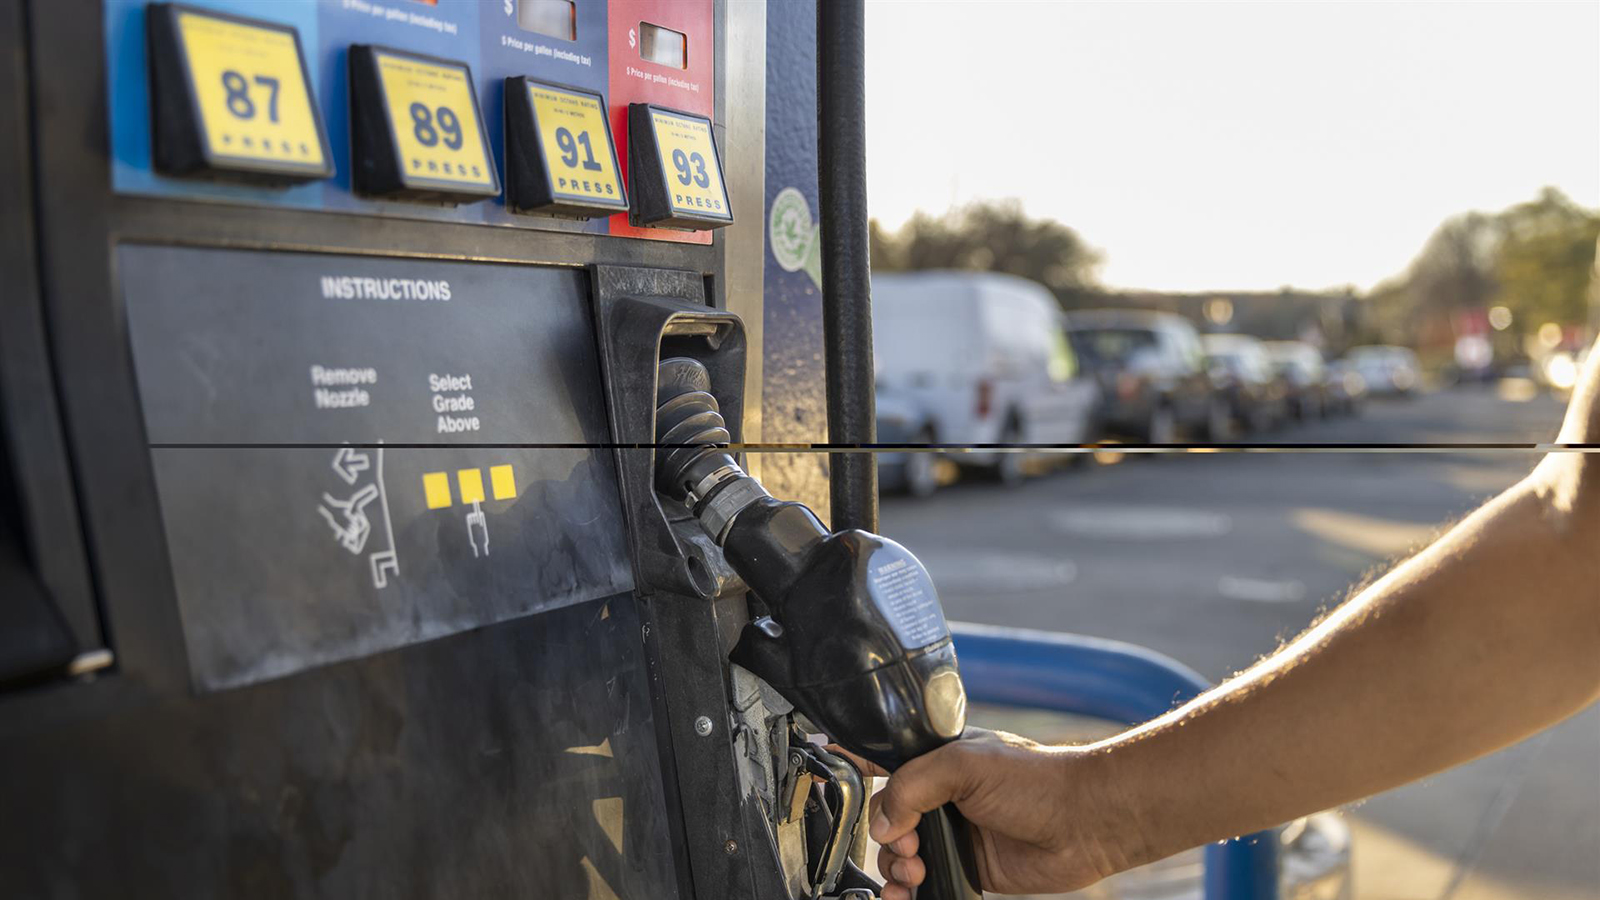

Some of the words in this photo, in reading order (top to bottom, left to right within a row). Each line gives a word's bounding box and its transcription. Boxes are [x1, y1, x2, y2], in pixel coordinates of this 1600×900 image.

[386, 8, 409, 22] gallon
[628, 28, 636, 50] $
[501, 35, 507, 46] $
[507, 36, 523, 50] Price
[524, 42, 534, 53] per
[535, 45, 553, 56] gallon
[553, 48, 580, 65] (including
[580, 55, 592, 67] tax)
[626, 66, 630, 76] $
[631, 67, 644, 79] Price
[644, 72, 652, 81] per
[653, 74, 668, 84] gallon
[668, 77, 690, 91] (including
[690, 82, 700, 93] tax)
[221, 70, 281, 124] 87
[409, 102, 464, 151] 89
[555, 126, 603, 173] 91
[412, 159, 482, 179] PRESS
[672, 148, 710, 189] 93
[558, 178, 613, 195] PRESS
[676, 194, 722, 210] PRESS
[320, 275, 452, 301] INSTRUCTIONS
[310, 364, 378, 386] Remove
[428, 373, 473, 392] Select
[314, 387, 371, 409] Nozzle
[432, 393, 475, 413] Grade
[437, 415, 480, 434] Above
